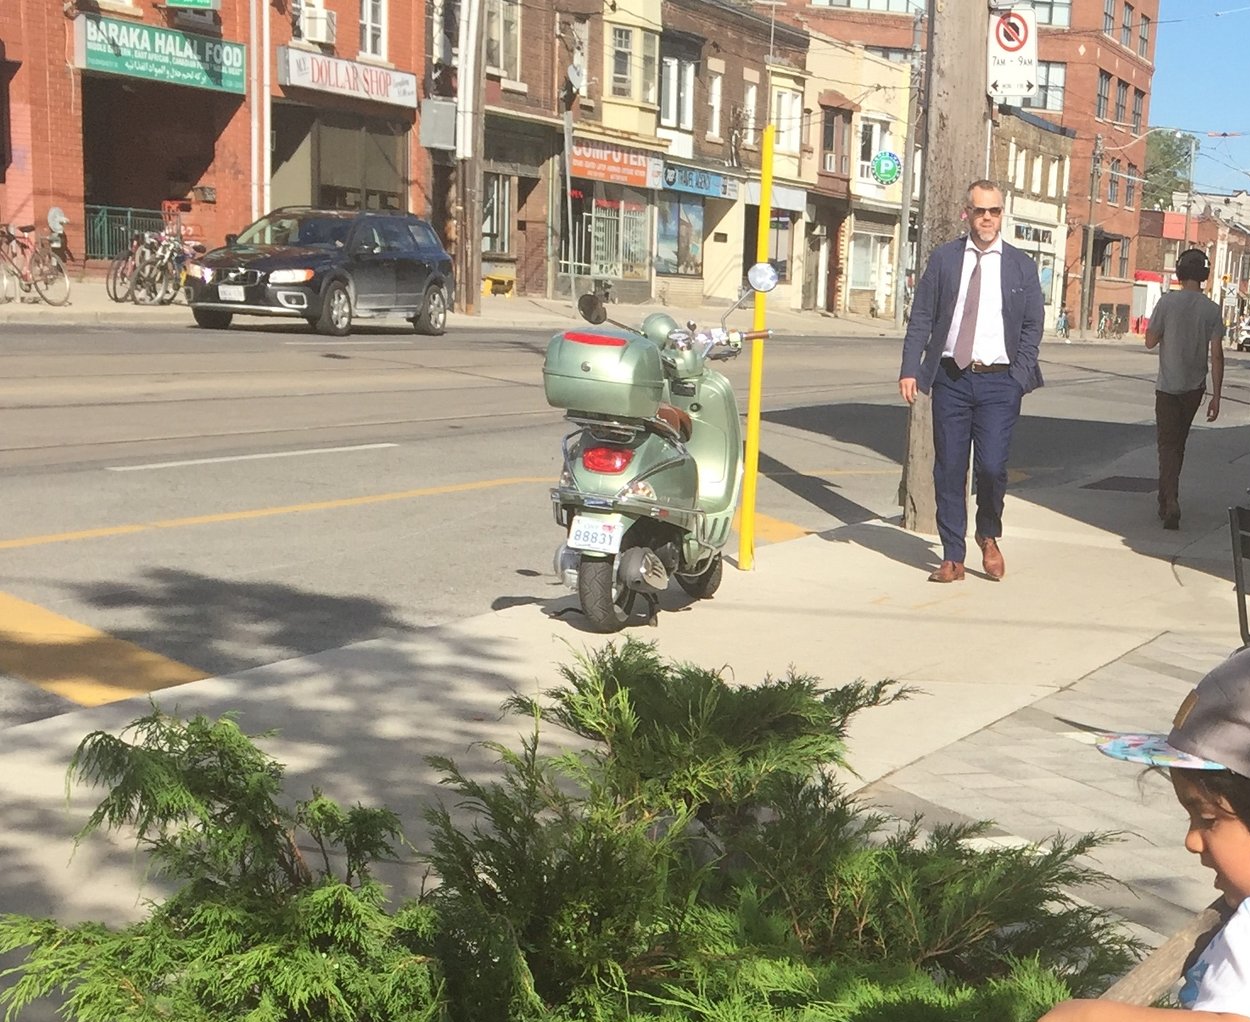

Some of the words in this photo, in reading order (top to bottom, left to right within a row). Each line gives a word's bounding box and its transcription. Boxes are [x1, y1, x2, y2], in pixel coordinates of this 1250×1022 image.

[86, 19, 150, 51] BARAKA
[154, 32, 201, 60] HALAL
[205, 42, 242, 67] FOOD
[993, 56, 1006, 66] 7AM
[1018, 56, 1033, 66] 9AM
[311, 57, 359, 91] DOLLAR
[363, 68, 392, 97] SHOP
[572, 141, 647, 167] COMPUTER
[880, 160, 894, 174] P
